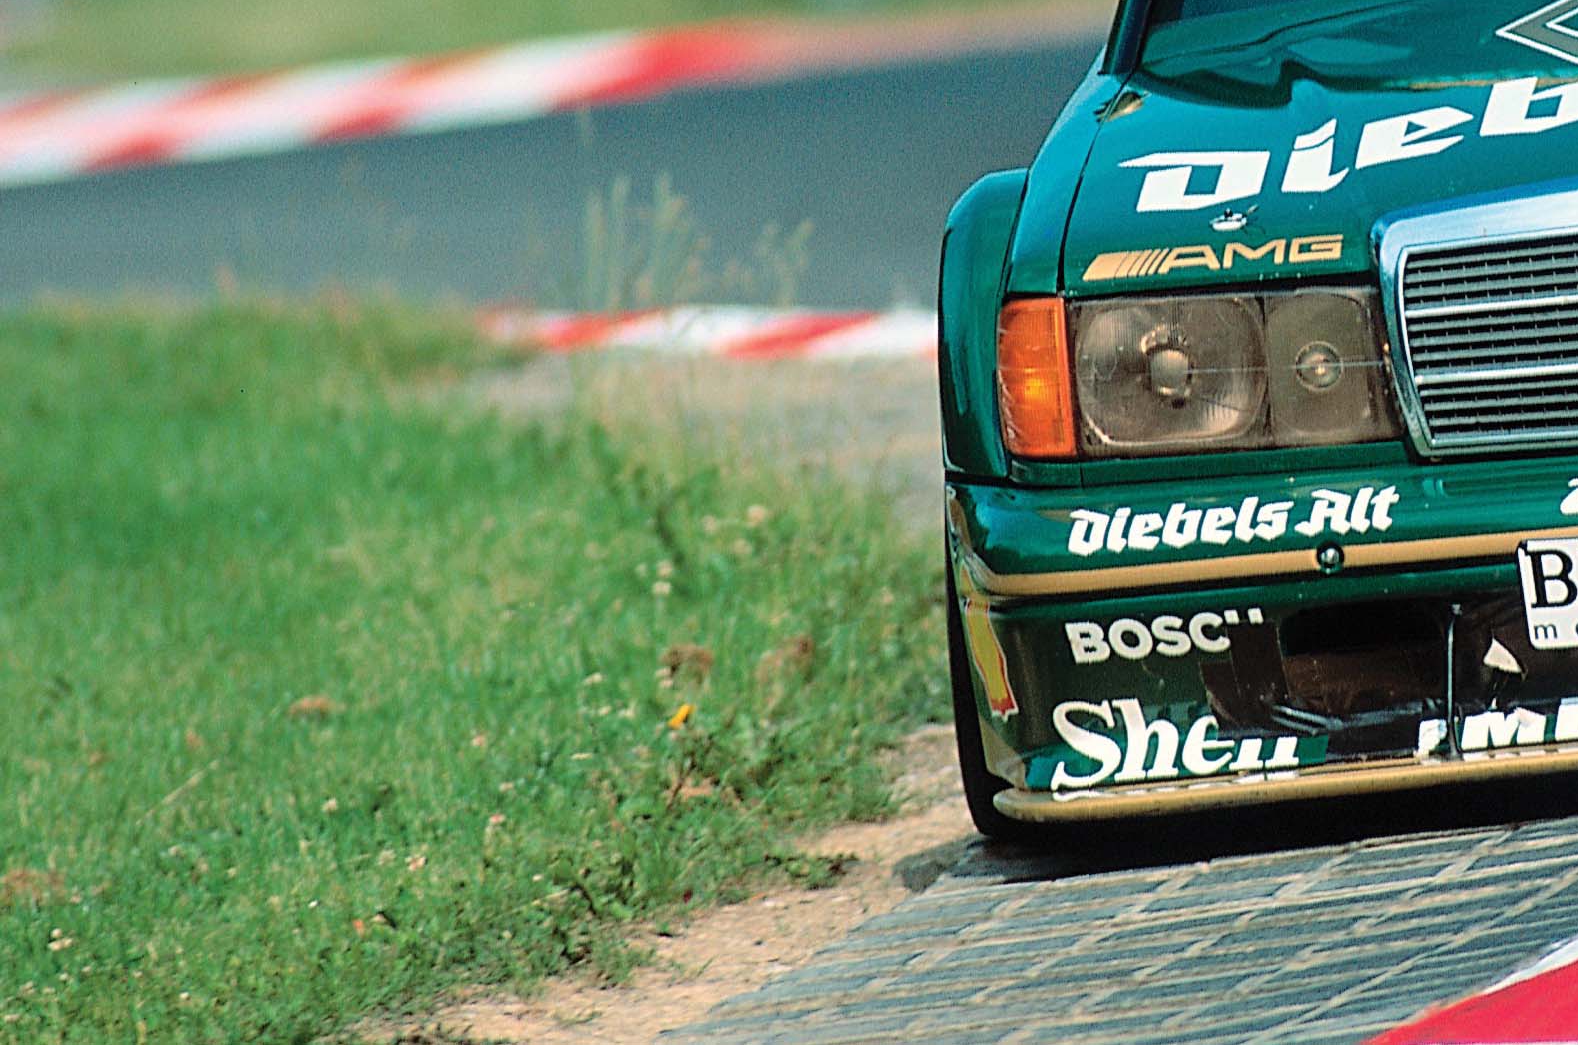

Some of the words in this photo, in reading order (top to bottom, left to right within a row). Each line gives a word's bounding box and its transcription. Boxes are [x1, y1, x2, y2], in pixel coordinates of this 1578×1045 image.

[1157, 233, 1344, 274] AMG
[1067, 496, 1295, 556] Diebels
[1295, 485, 1400, 537] Alt
